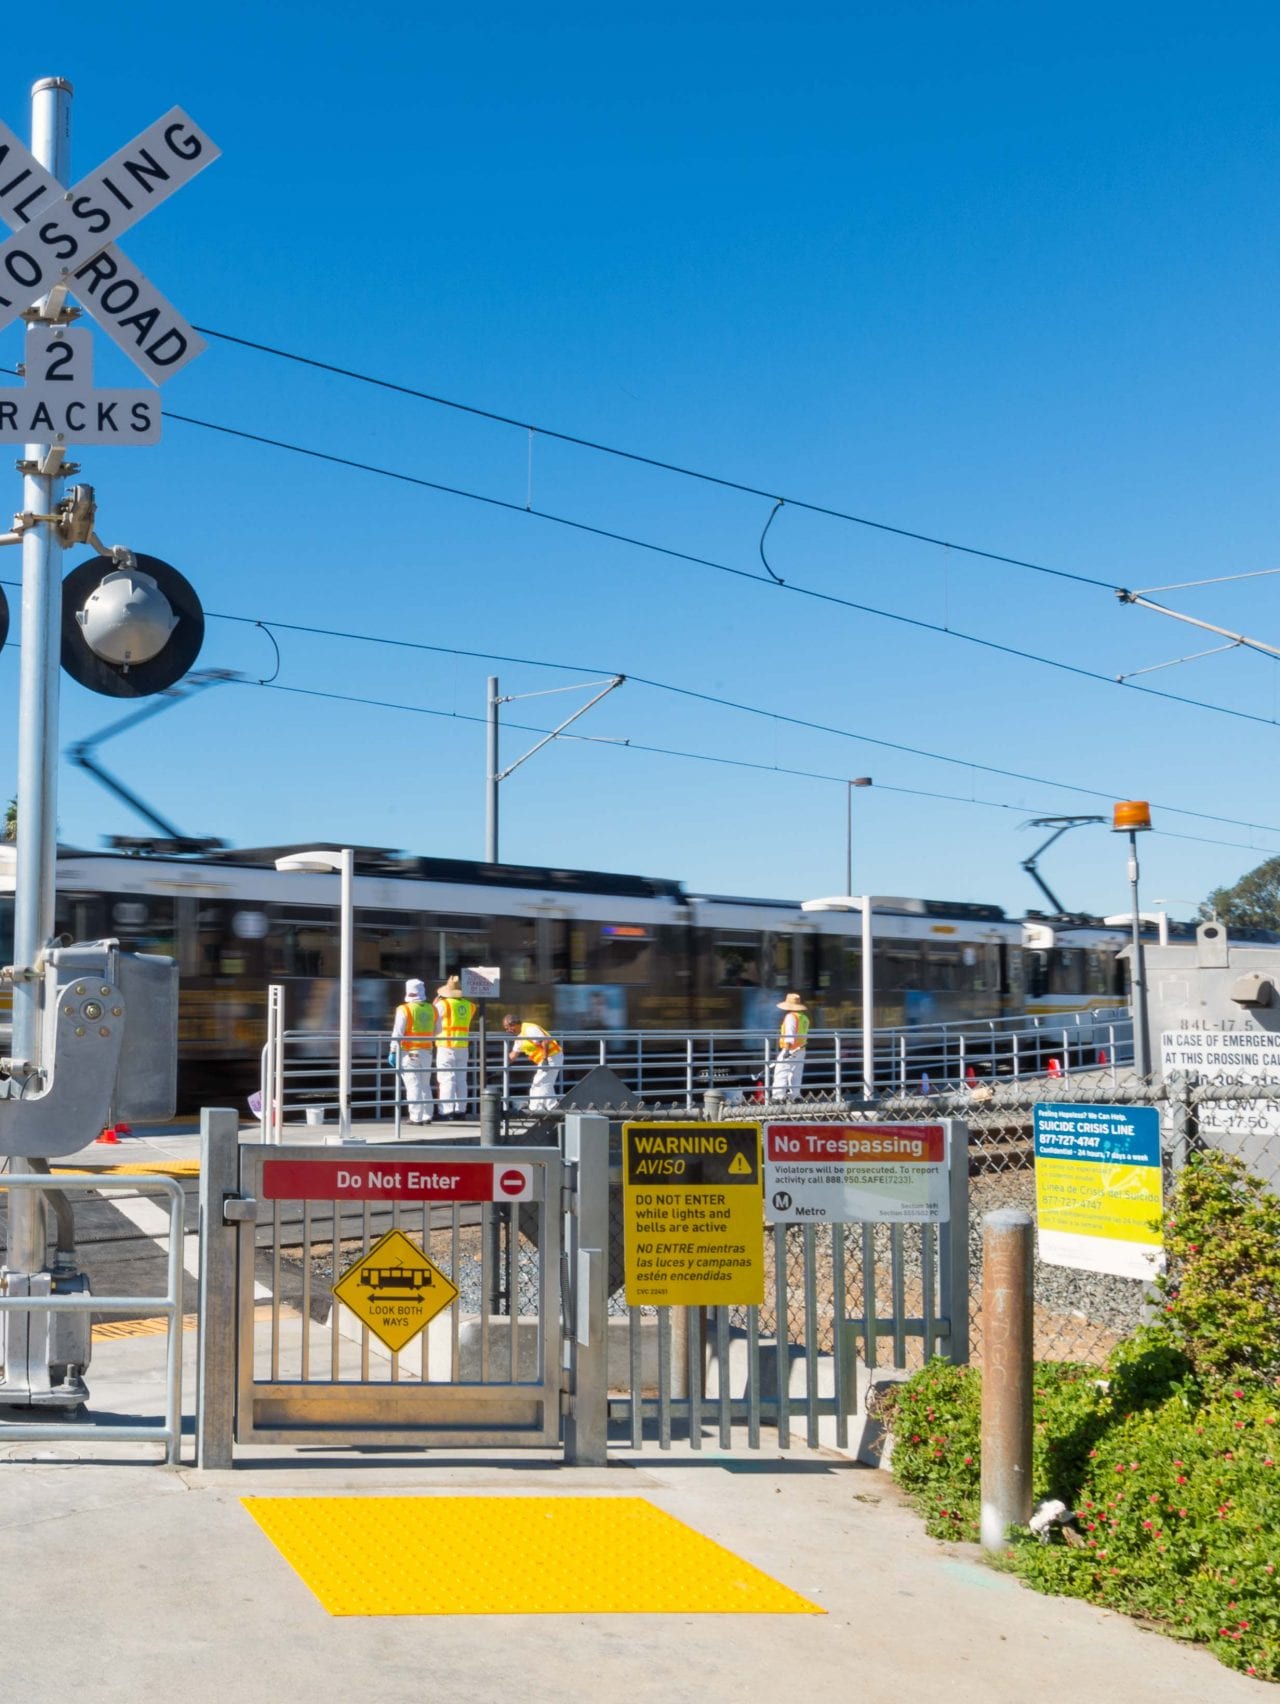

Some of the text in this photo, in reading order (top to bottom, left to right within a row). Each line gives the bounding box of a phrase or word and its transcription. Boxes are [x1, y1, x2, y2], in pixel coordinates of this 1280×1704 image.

[45, 342, 74, 381] 2
[1163, 1035, 1173, 1046] IN
[1176, 1035, 1202, 1046] CASE
[1206, 1035, 1220, 1046] OF
[1166, 1053, 1176, 1063] AT
[1180, 1053, 1203, 1064] THIS
[1207, 1053, 1258, 1065] CROSSING
[1111, 1113, 1127, 1121] Help.
[1039, 1121, 1135, 1136] SUICIDE CRISIS LINE
[634, 1137, 728, 1153] WARNING
[1039, 1134, 1100, 1147] 877-727-4747
[775, 1136, 922, 1157] No Trespassing
[1039, 1146, 1073, 1155] Confidential
[1087, 1150, 1105, 1158] hours,
[1111, 1152, 1126, 1161] days
[636, 1159, 686, 1174] AVISO
[775, 1166, 939, 1175] Violators will be prosecuted. To report
[337, 1171, 460, 1190] Do Not Enter
[775, 1176, 806, 1185] activity
[807, 1176, 823, 1184] call
[1067, 1185, 1077, 1194] de
[1080, 1185, 1105, 1196] Crisis
[636, 1195, 725, 1205] DO NOT ENTER
[774, 1193, 791, 1209] M
[1042, 1195, 1102, 1210] 877-727-4747
[636, 1209, 731, 1220] while lights and
[795, 1207, 826, 1216] Metro
[637, 1222, 666, 1232] bells
[692, 1222, 727, 1232] active
[636, 1244, 746, 1253] NO ENTRE mientras
[636, 1258, 751, 1269] las luces y campanas
[637, 1271, 732, 1280] estén encendidas
[369, 1306, 423, 1315] LOOK BOTH
[383, 1317, 409, 1326] WAYS
